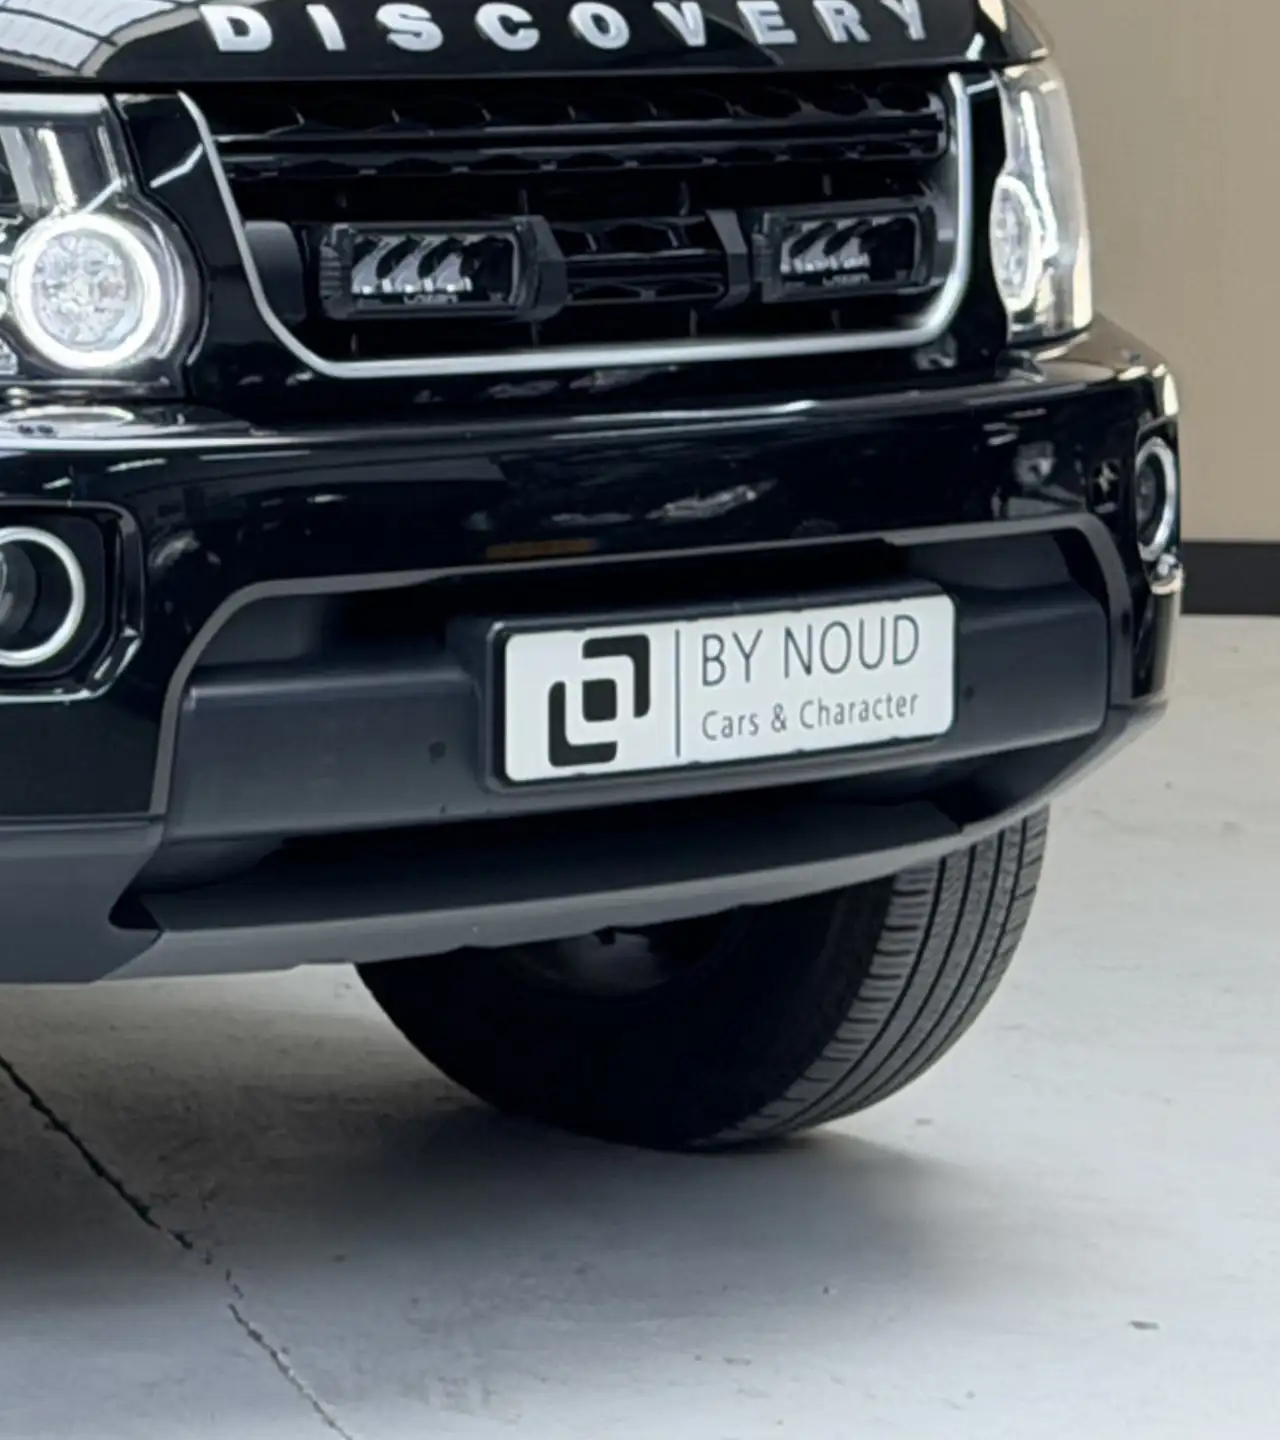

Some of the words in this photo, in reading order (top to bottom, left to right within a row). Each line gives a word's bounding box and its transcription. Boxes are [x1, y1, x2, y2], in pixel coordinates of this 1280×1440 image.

[701, 628, 764, 688] BY
[783, 613, 920, 679] NOUD
[701, 710, 760, 742] Cars
[770, 703, 788, 732] &
[798, 691, 920, 731] Character
